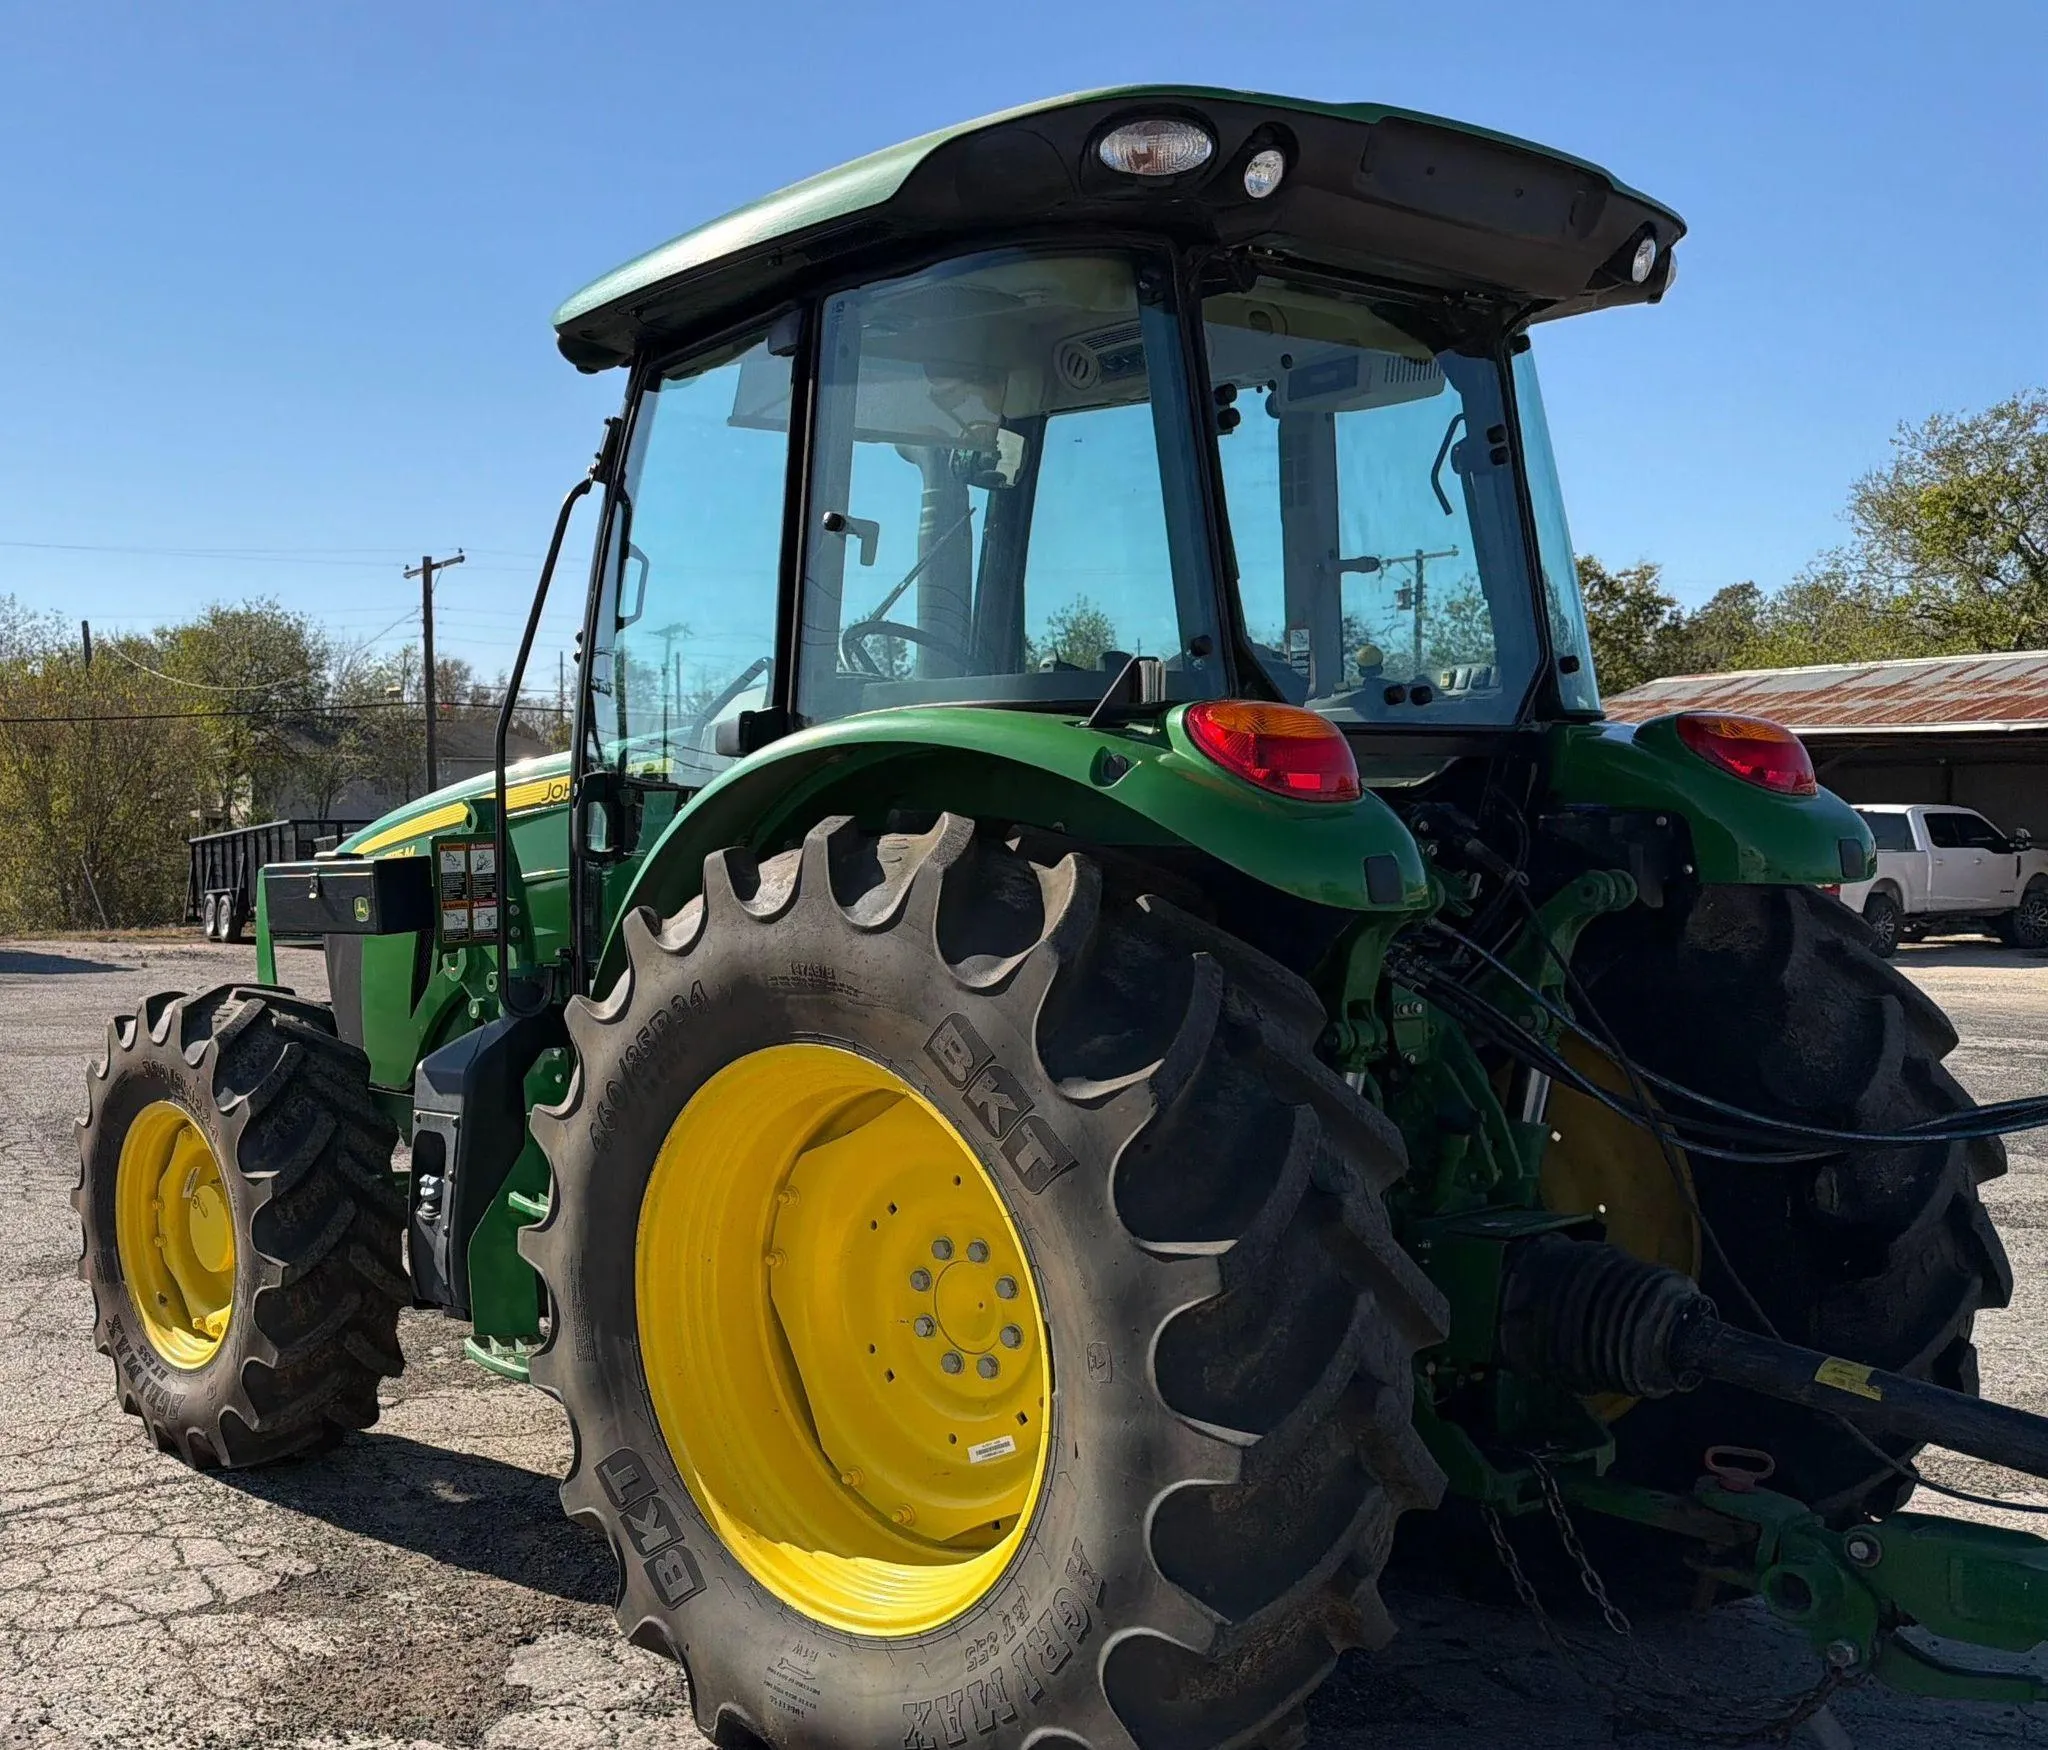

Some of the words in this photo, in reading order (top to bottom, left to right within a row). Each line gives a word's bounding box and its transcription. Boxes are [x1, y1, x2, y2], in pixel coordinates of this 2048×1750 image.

[926, 1016, 1070, 1186] BKT
[603, 1453, 697, 1605] BKT
[902, 1536, 1105, 1750] AGRIMAX
[965, 1631, 1000, 1673] 855
